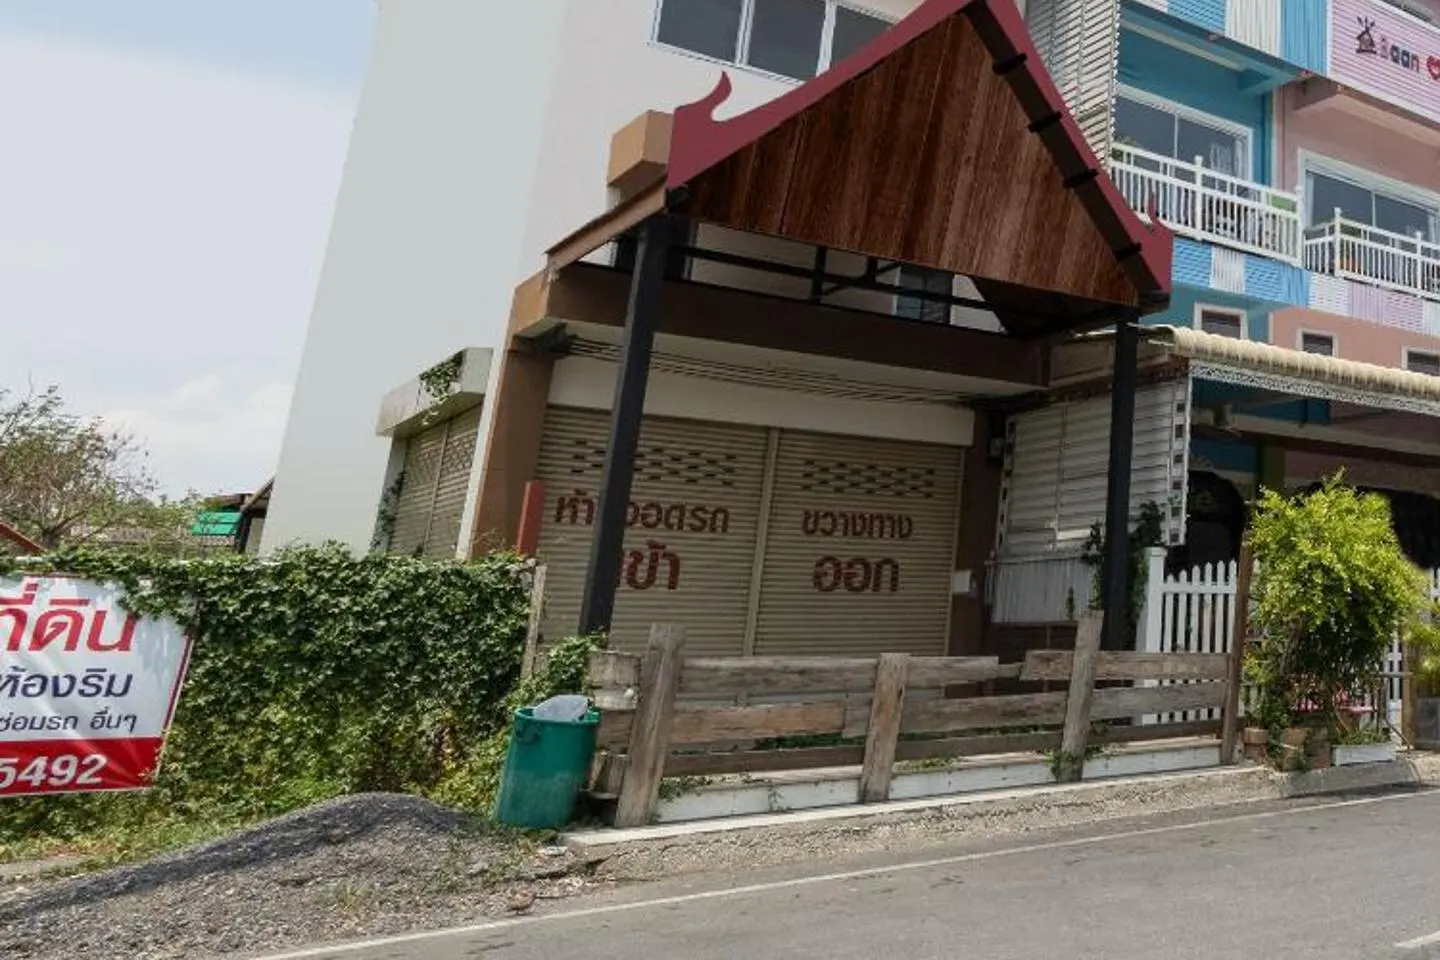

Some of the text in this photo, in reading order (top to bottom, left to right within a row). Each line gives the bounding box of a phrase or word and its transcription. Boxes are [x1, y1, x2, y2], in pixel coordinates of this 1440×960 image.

[555, 488, 730, 533] ห้าจอดรถ
[812, 556, 899, 592] ออก
